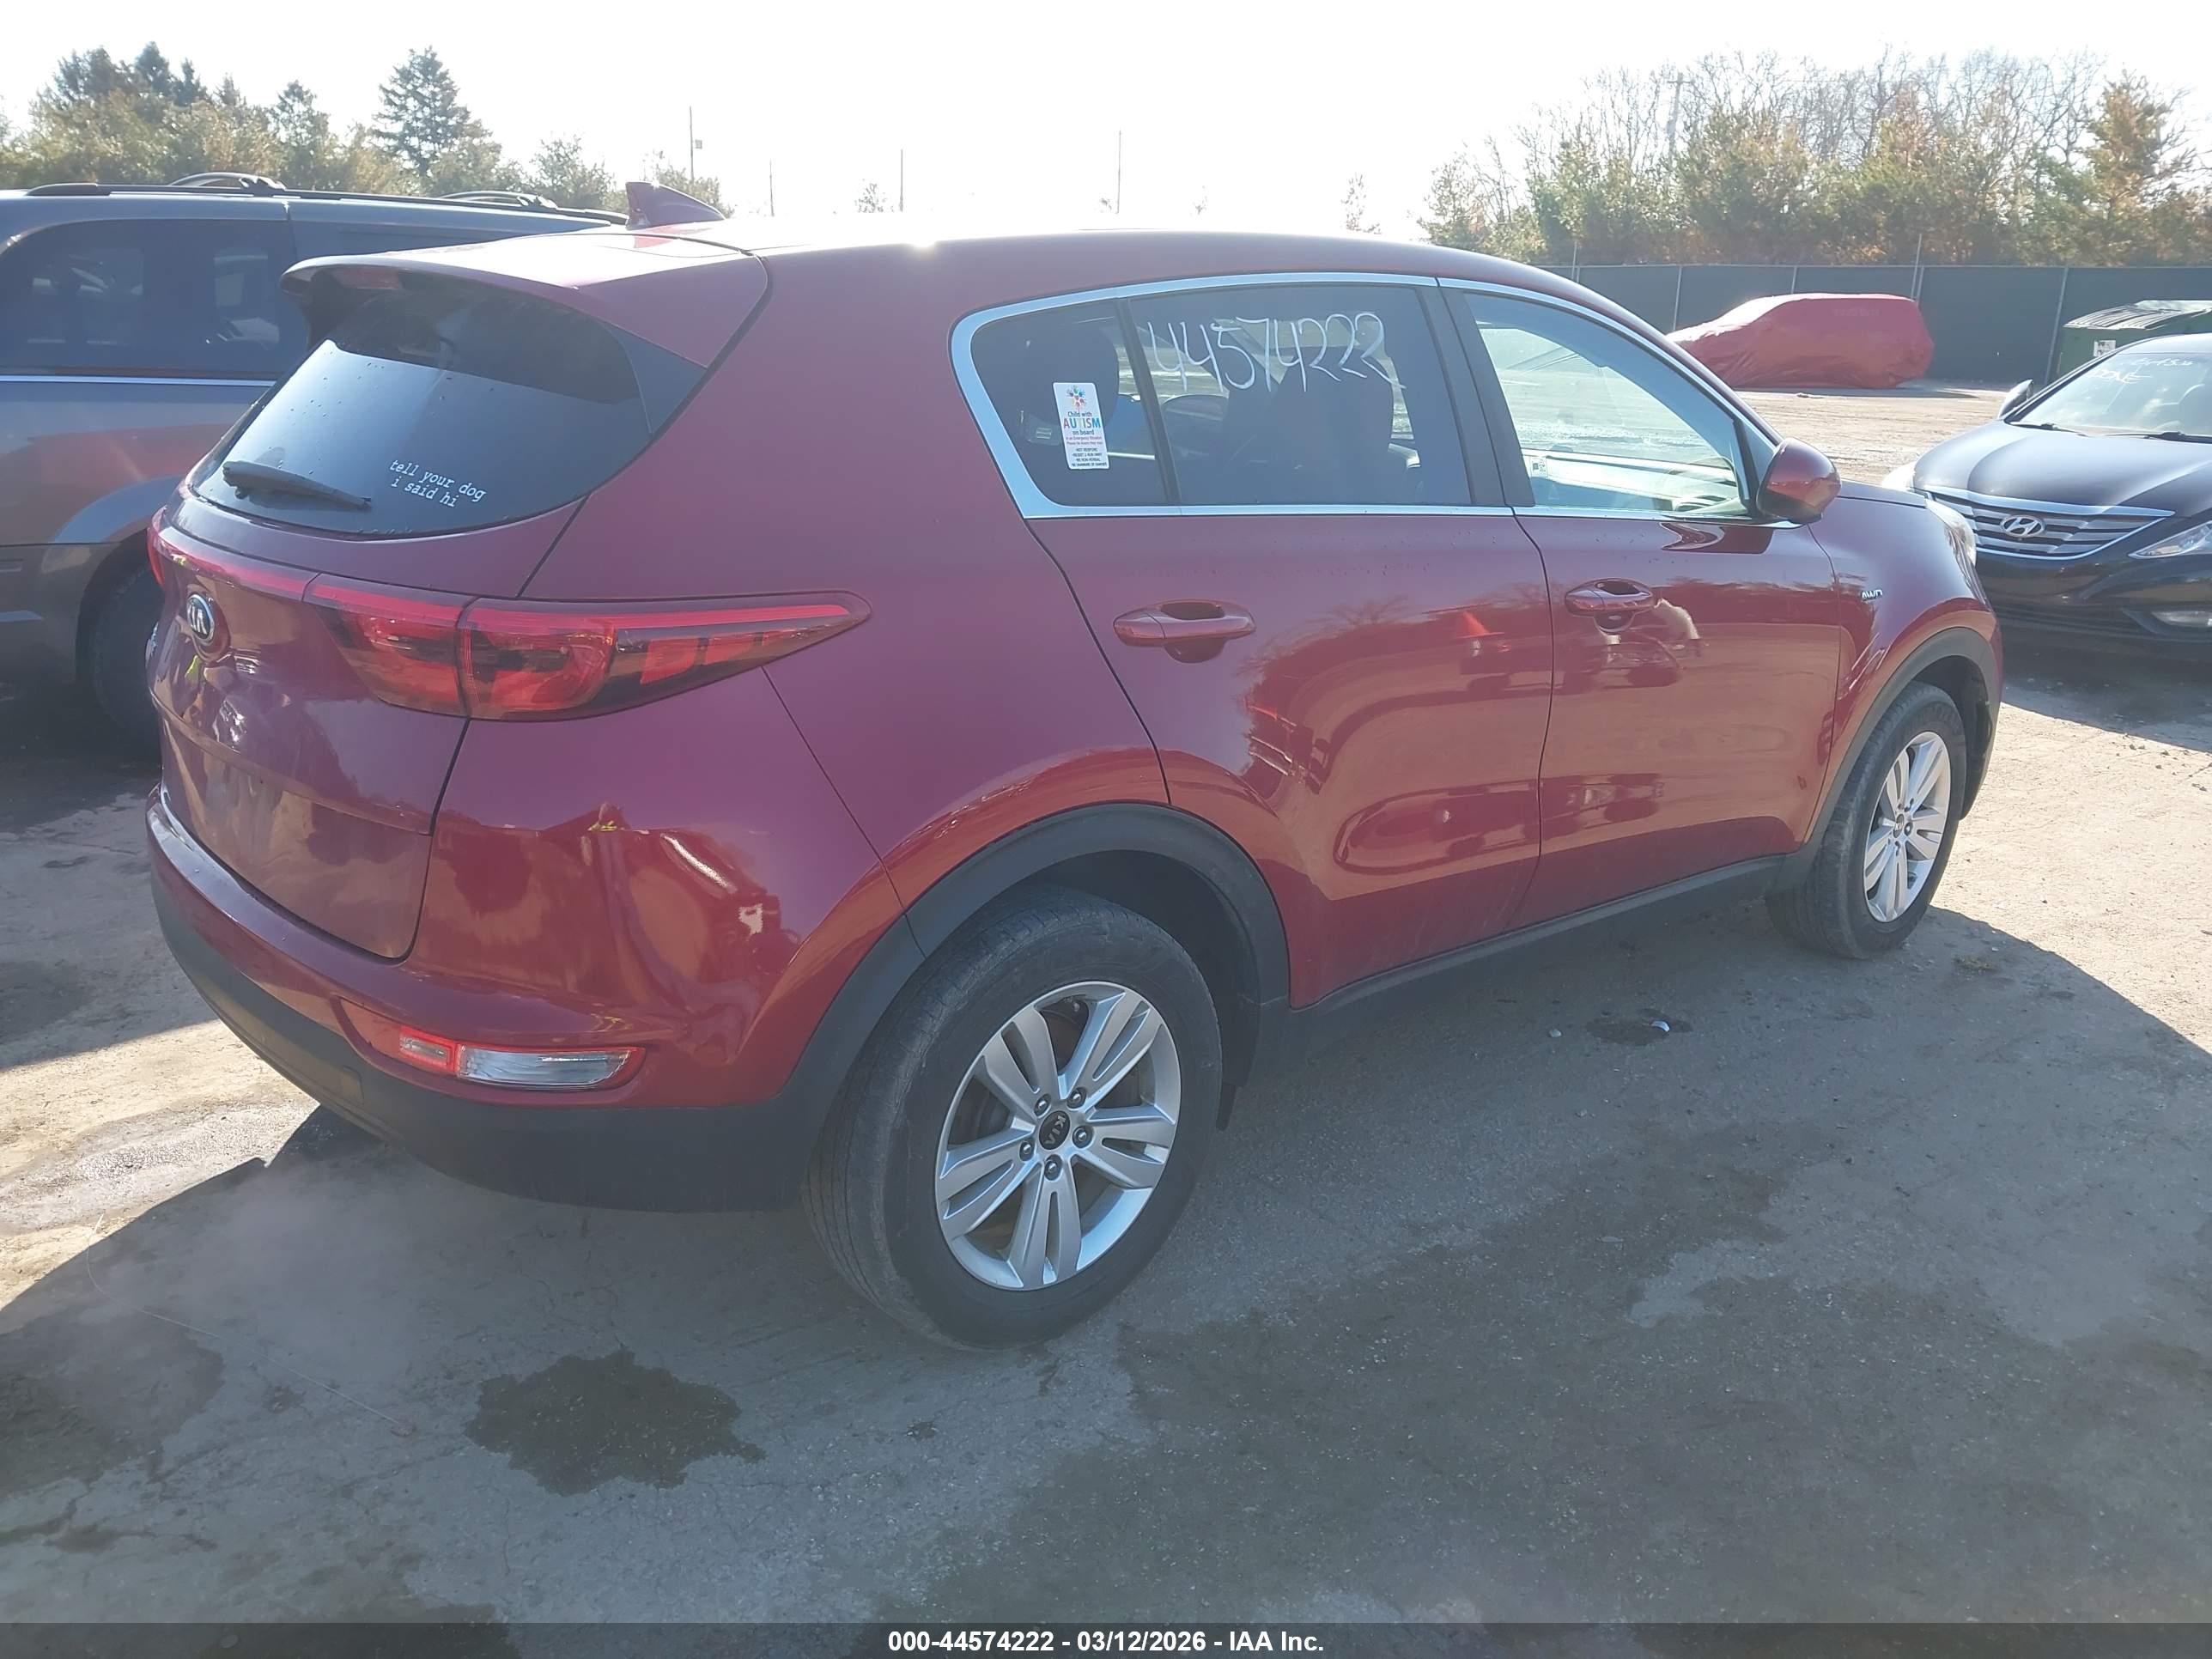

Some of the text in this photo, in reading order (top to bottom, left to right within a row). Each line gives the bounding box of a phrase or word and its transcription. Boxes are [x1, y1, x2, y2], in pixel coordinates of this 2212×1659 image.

[1146, 312, 1407, 392] 44574222
[1064, 417, 1101, 428] AUTISM
[390, 459, 487, 502] tell your dog
[391, 476, 459, 507] i said hi
[1044, 1115, 1066, 1144] KIA
